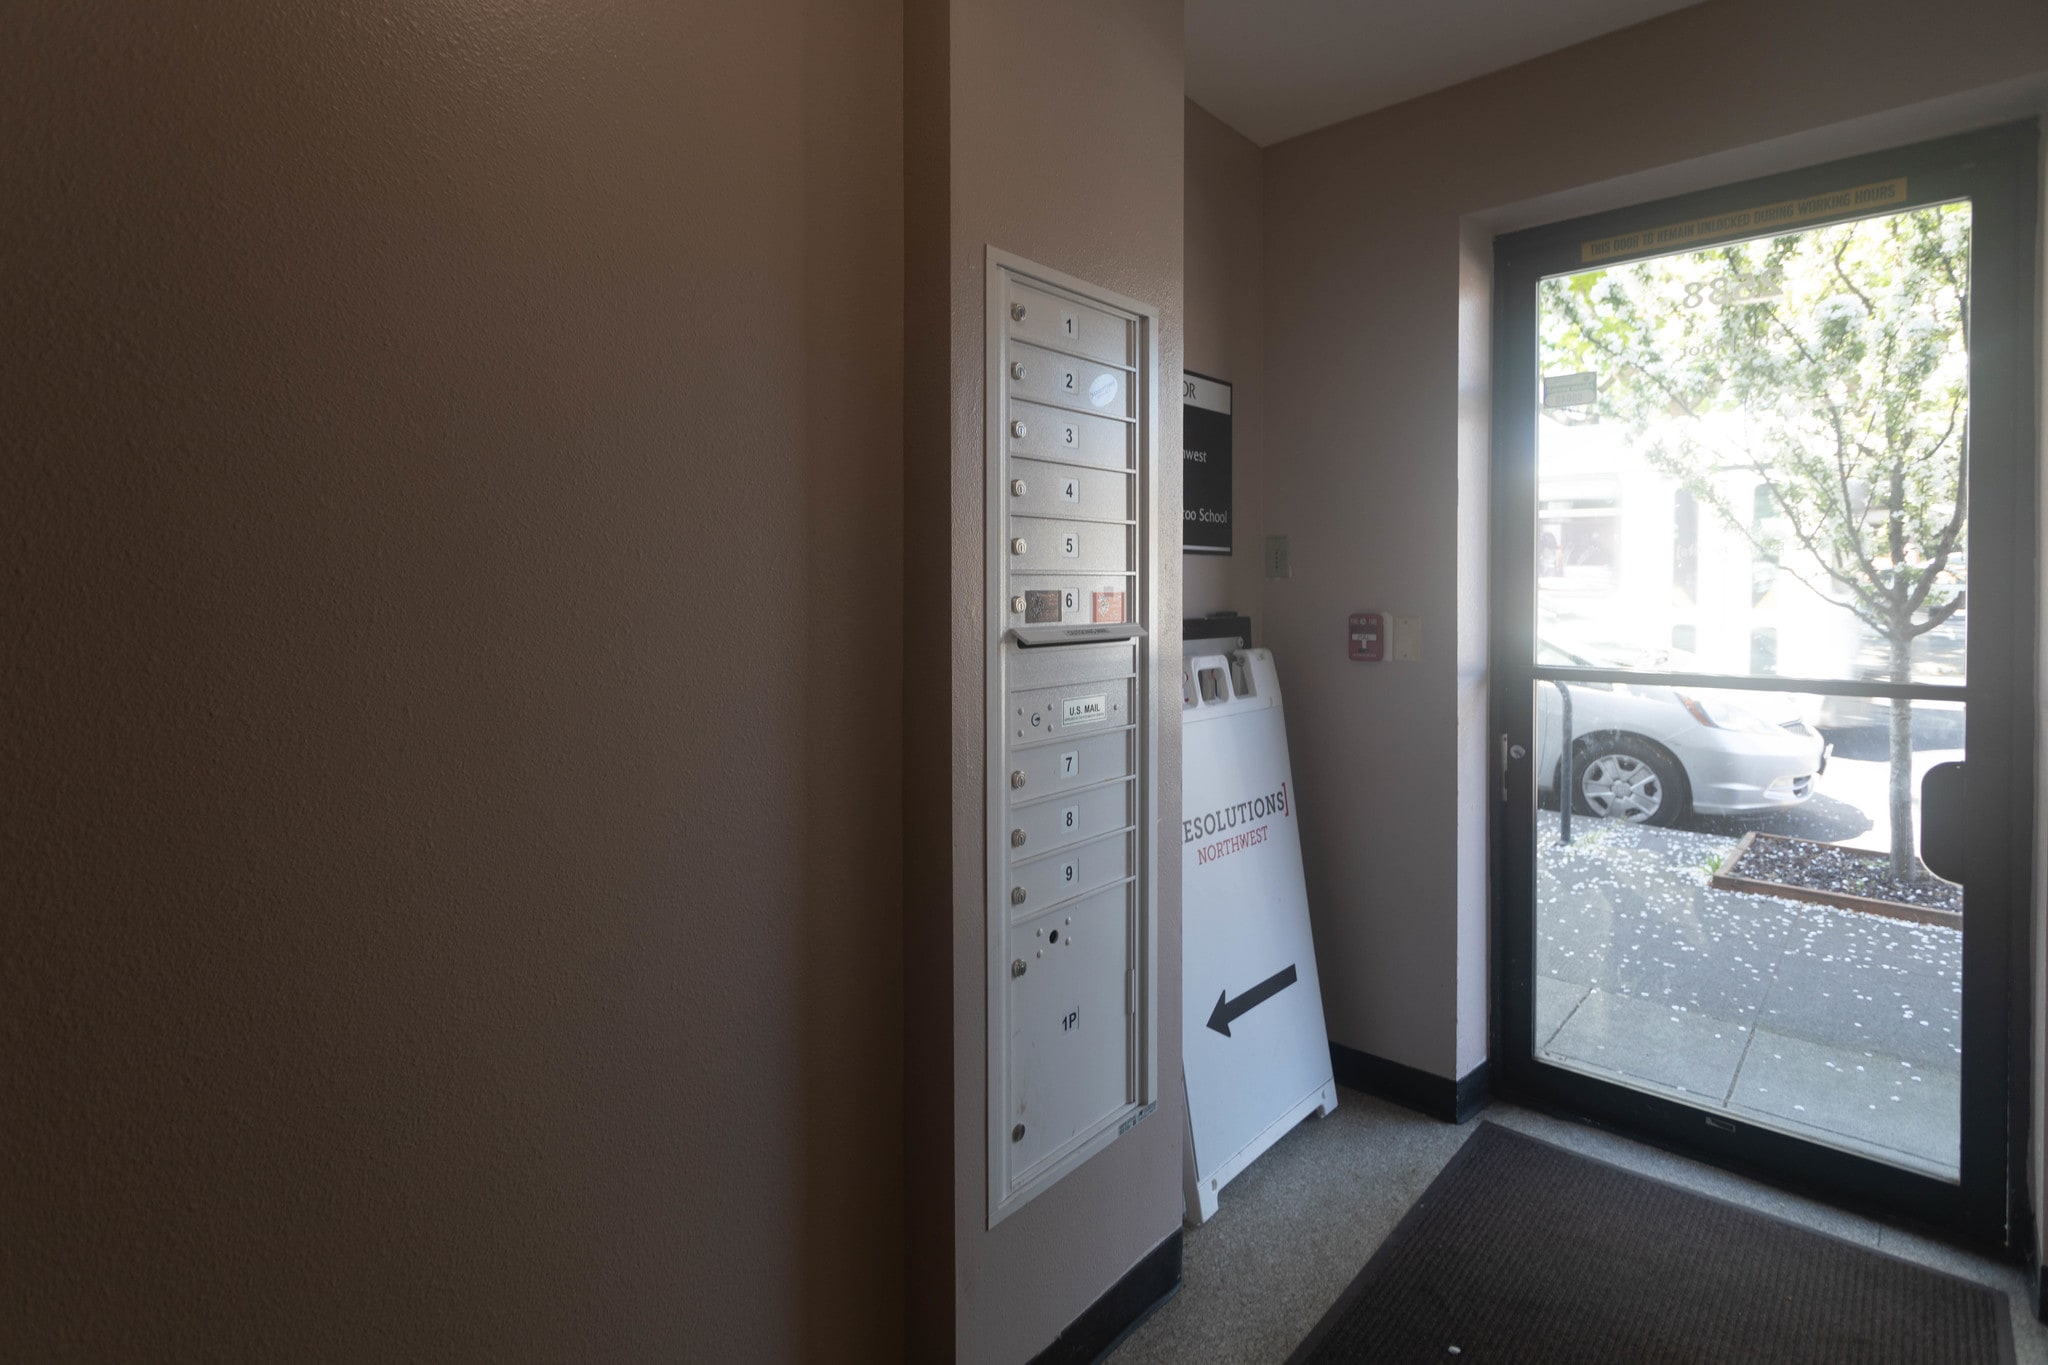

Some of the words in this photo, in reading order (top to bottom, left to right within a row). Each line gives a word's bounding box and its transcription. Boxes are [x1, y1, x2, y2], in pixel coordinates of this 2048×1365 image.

[1591, 243, 1611, 256] THIS
[1613, 237, 1639, 252] DOOR
[1643, 232, 1654, 245] TO
[1657, 225, 1694, 242] REMAIN
[1697, 212, 1750, 234] UNLOCKED
[1754, 204, 1793, 224] DURING
[1798, 193, 1850, 216] WORKING
[1854, 183, 1896, 205] HOURS
[1066, 318, 1072, 334] 1
[1066, 373, 1073, 389] 2
[1066, 428, 1073, 444] 3
[1066, 483, 1073, 498] 4
[1199, 507, 1228, 524] School
[1066, 538, 1073, 553] 5
[1066, 593, 1073, 608] 6
[1069, 705, 1082, 717] U.S.
[1084, 703, 1100, 714] MAIL
[1065, 756, 1073, 772] 7
[1066, 811, 1073, 827] 8
[1197, 825, 1268, 866] NORTHWEST
[1065, 865, 1073, 882] 9
[1062, 1012, 1078, 1031] 1P
